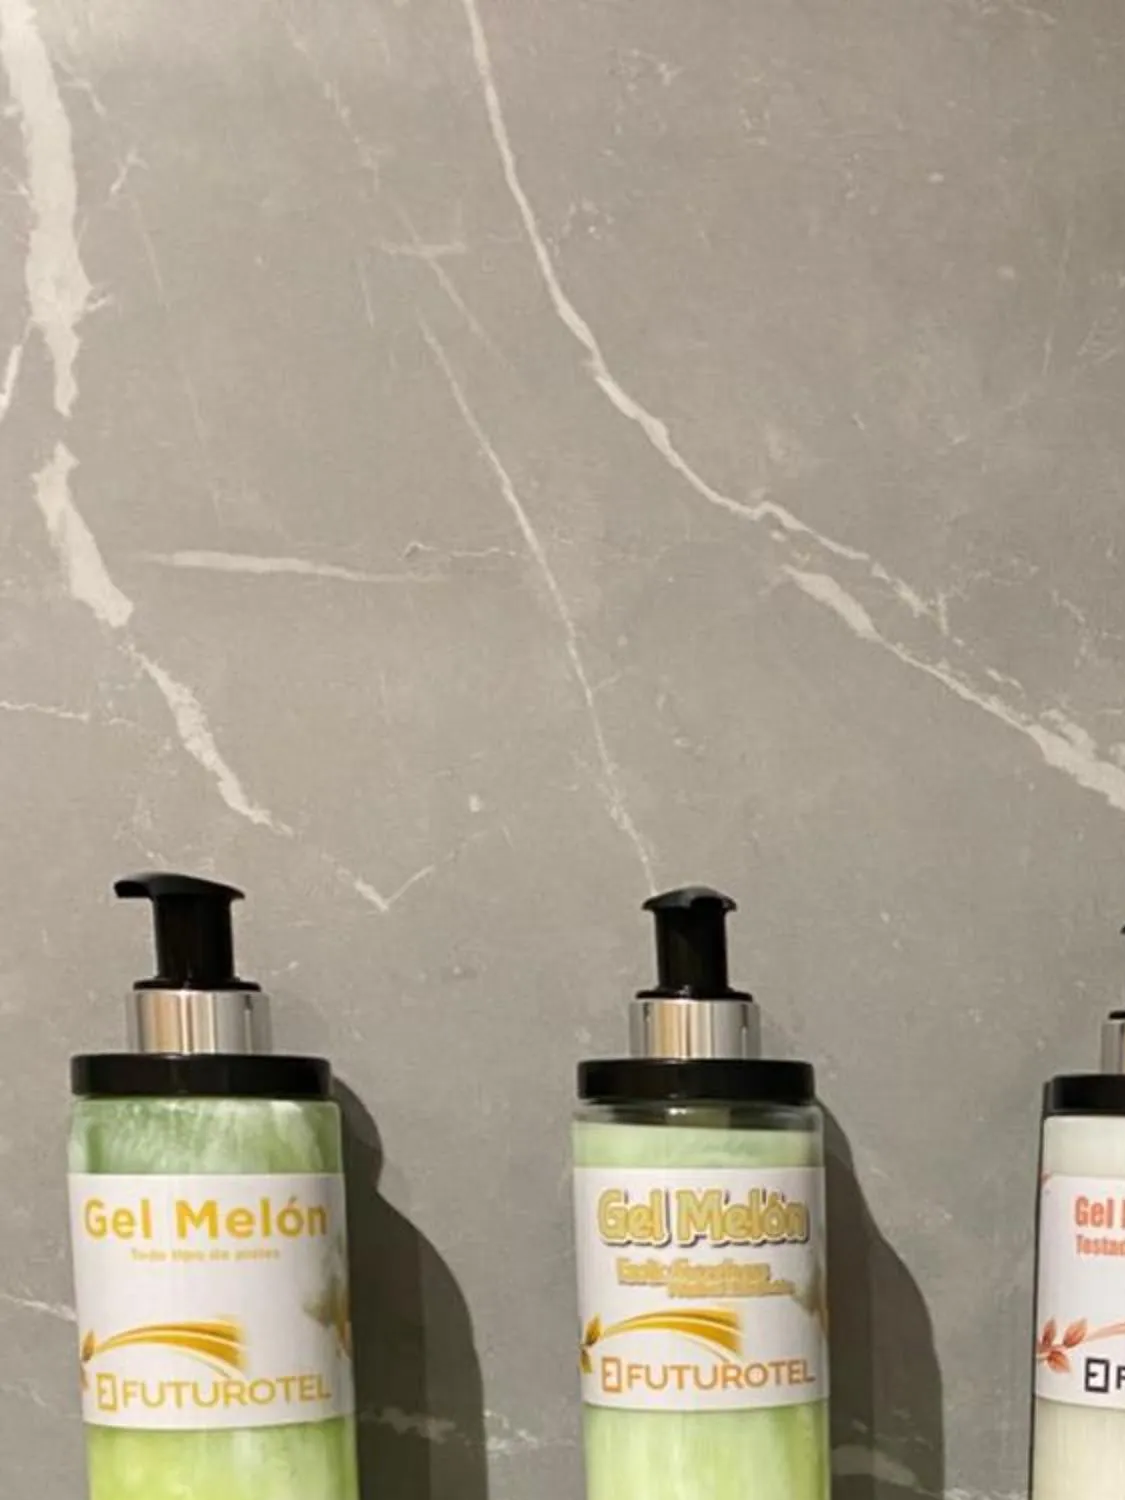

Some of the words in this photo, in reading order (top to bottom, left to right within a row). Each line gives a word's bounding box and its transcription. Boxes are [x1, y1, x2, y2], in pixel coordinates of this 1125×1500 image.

[84, 1197, 152, 1240] Gel
[175, 1195, 327, 1240] Melón
[597, 1188, 671, 1247] Gel
[675, 1188, 808, 1247] Melón
[1074, 1195, 1114, 1228] Gel
[123, 1373, 333, 1408] FUTUROTEL
[628, 1358, 816, 1390] FUTUROTEL
